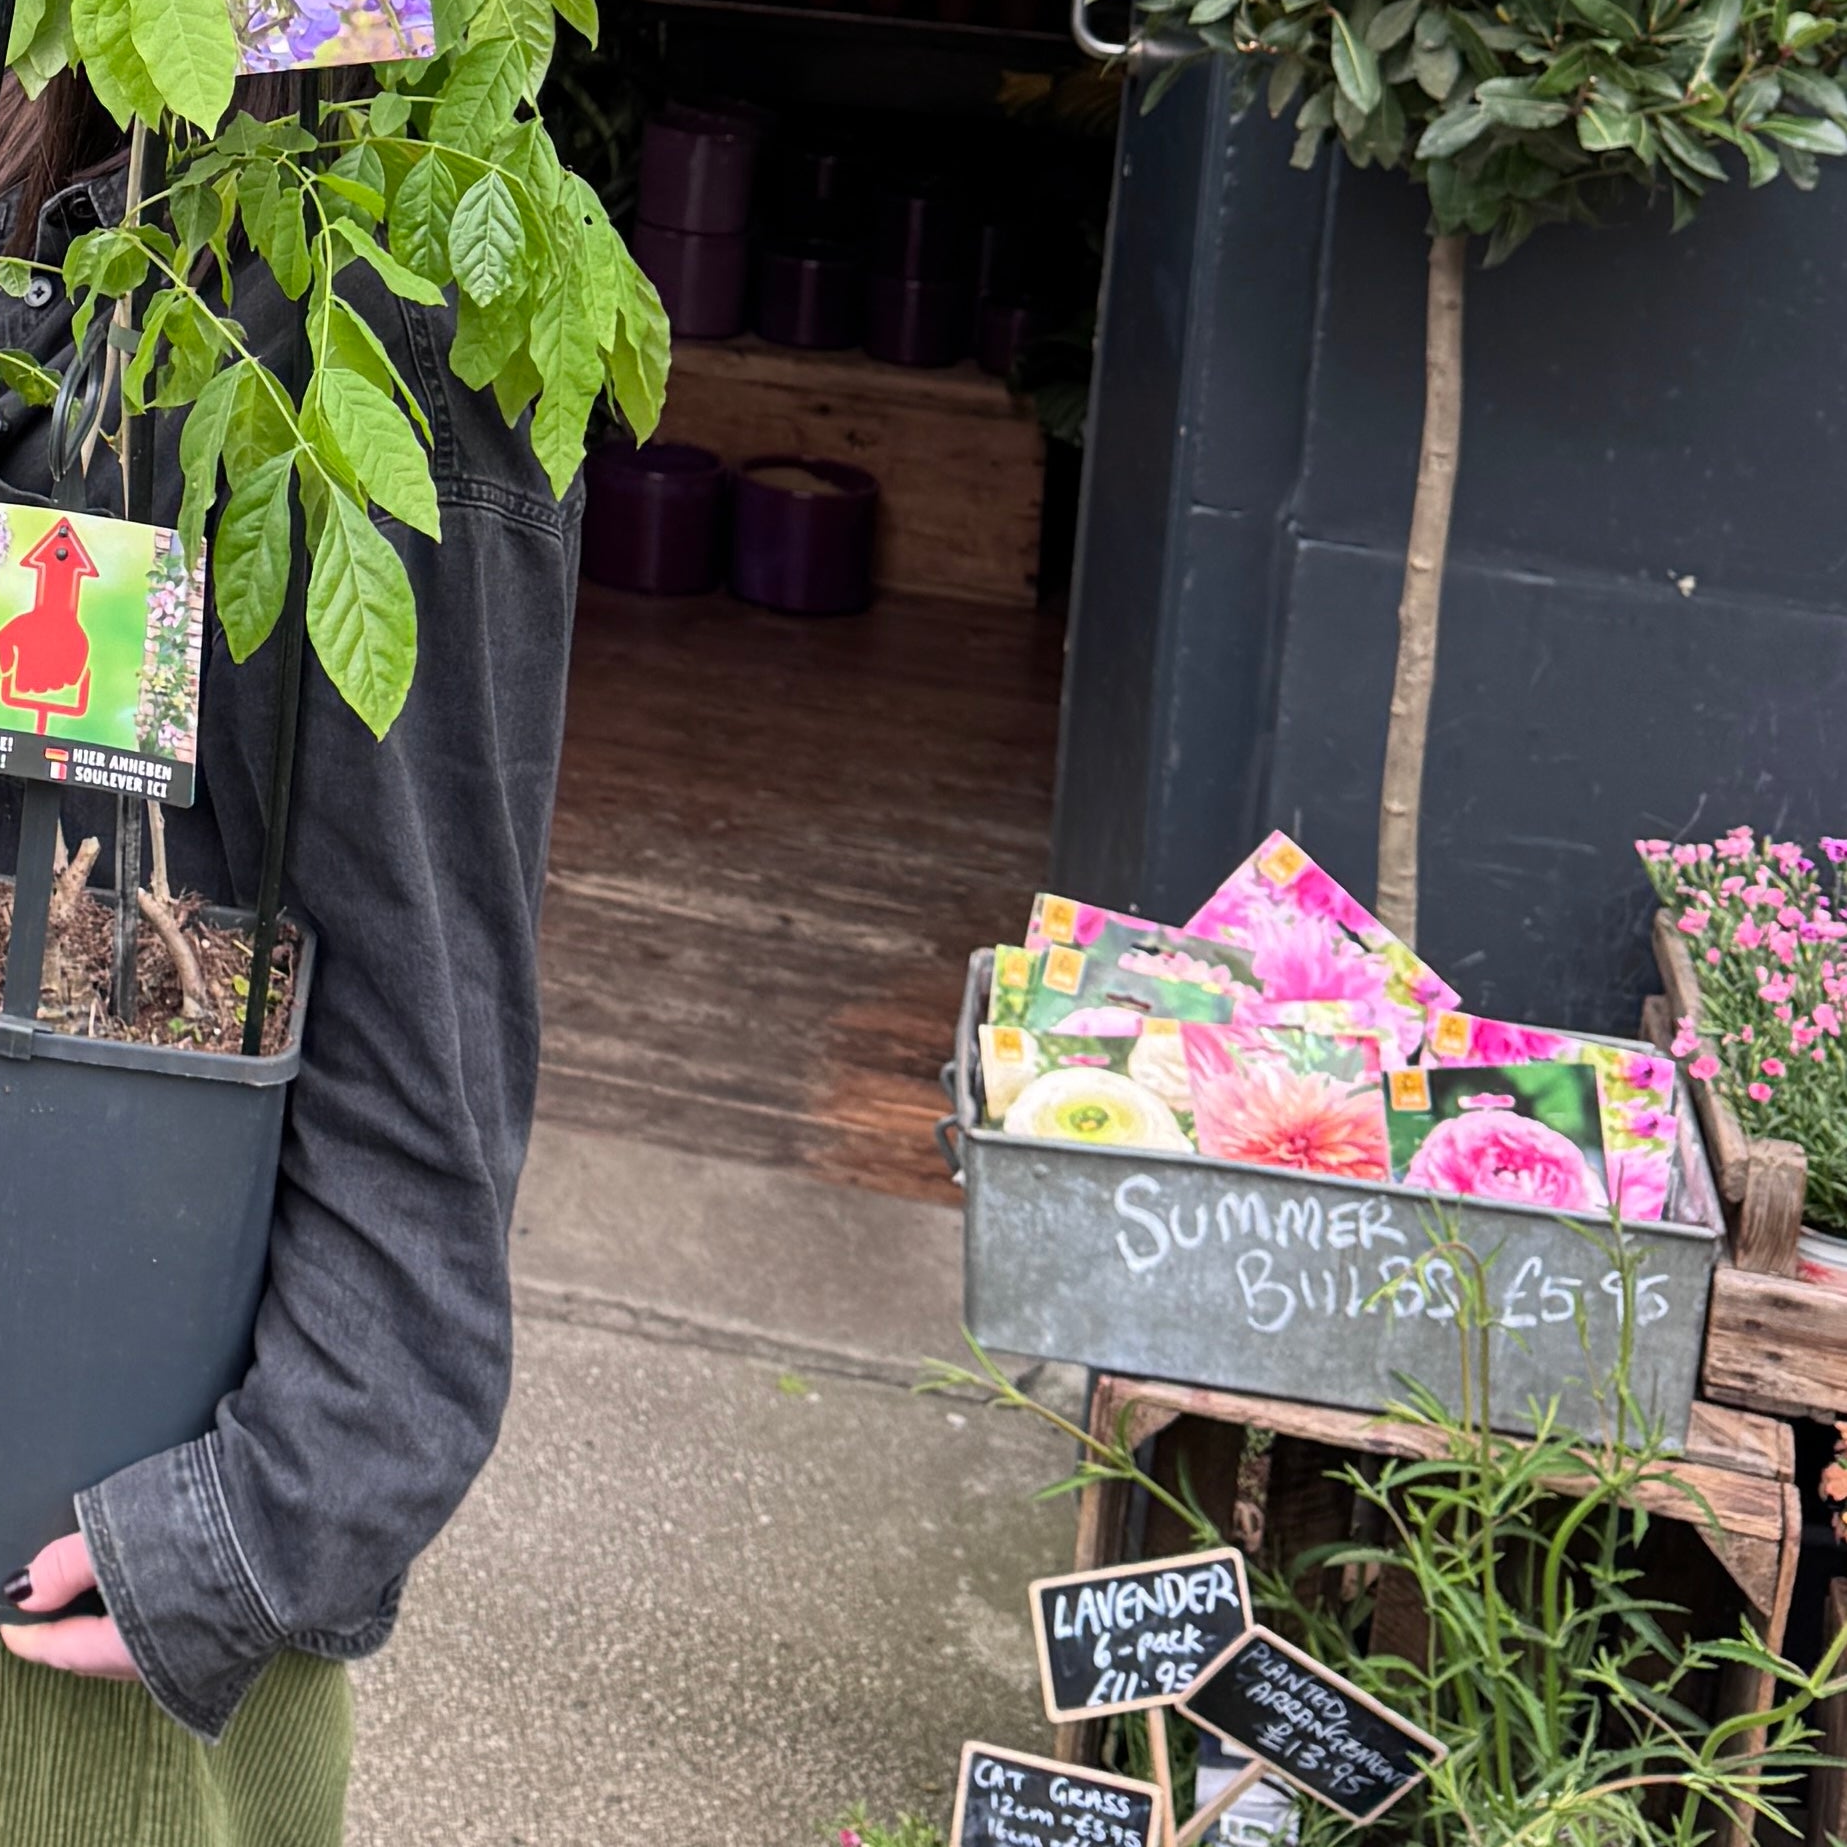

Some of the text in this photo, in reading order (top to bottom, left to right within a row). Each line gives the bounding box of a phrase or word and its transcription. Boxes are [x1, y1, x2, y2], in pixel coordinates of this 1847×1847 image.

[72, 748, 173, 781] HIER ANHEBEN
[74, 765, 168, 799] SOULEVER ICI
[1114, 1174, 1408, 1273] SUMMER
[1054, 1563, 1240, 1640] LAVENDER
[1239, 1641, 1348, 1719] PLANTED
[973, 1758, 1131, 1819] CAT GRASS
[1256, 1722, 1376, 1795] £13.95
[990, 1792, 1055, 1827] 12cm
